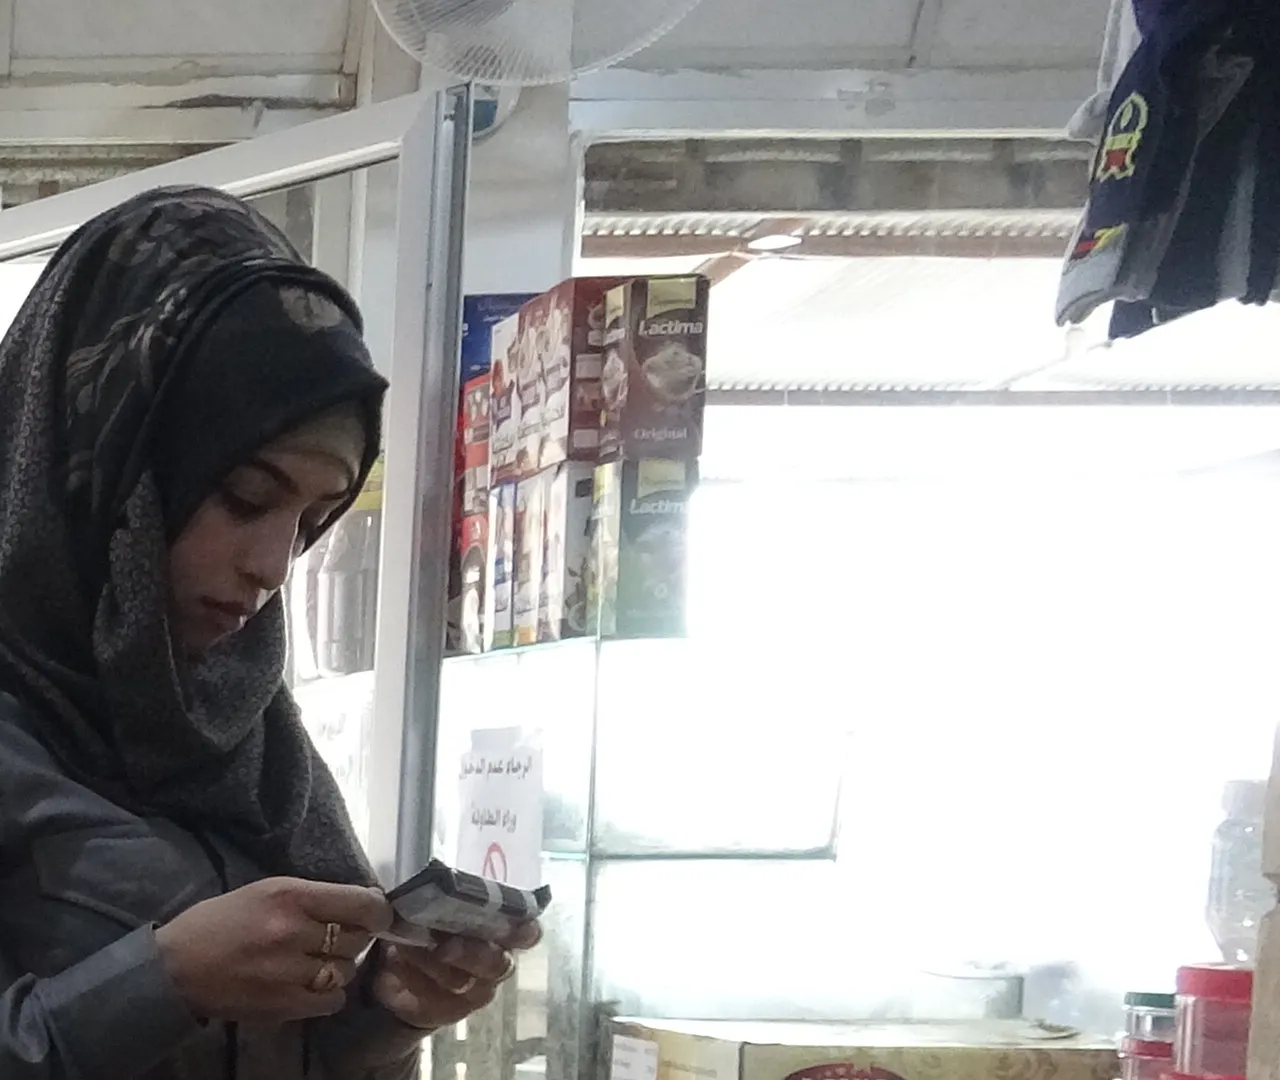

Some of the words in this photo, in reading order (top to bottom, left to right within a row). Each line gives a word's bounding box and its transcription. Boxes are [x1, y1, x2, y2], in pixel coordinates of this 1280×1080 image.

[639, 319, 705, 336] Lactima
[634, 427, 688, 442] Original
[629, 498, 686, 515] Lactim
